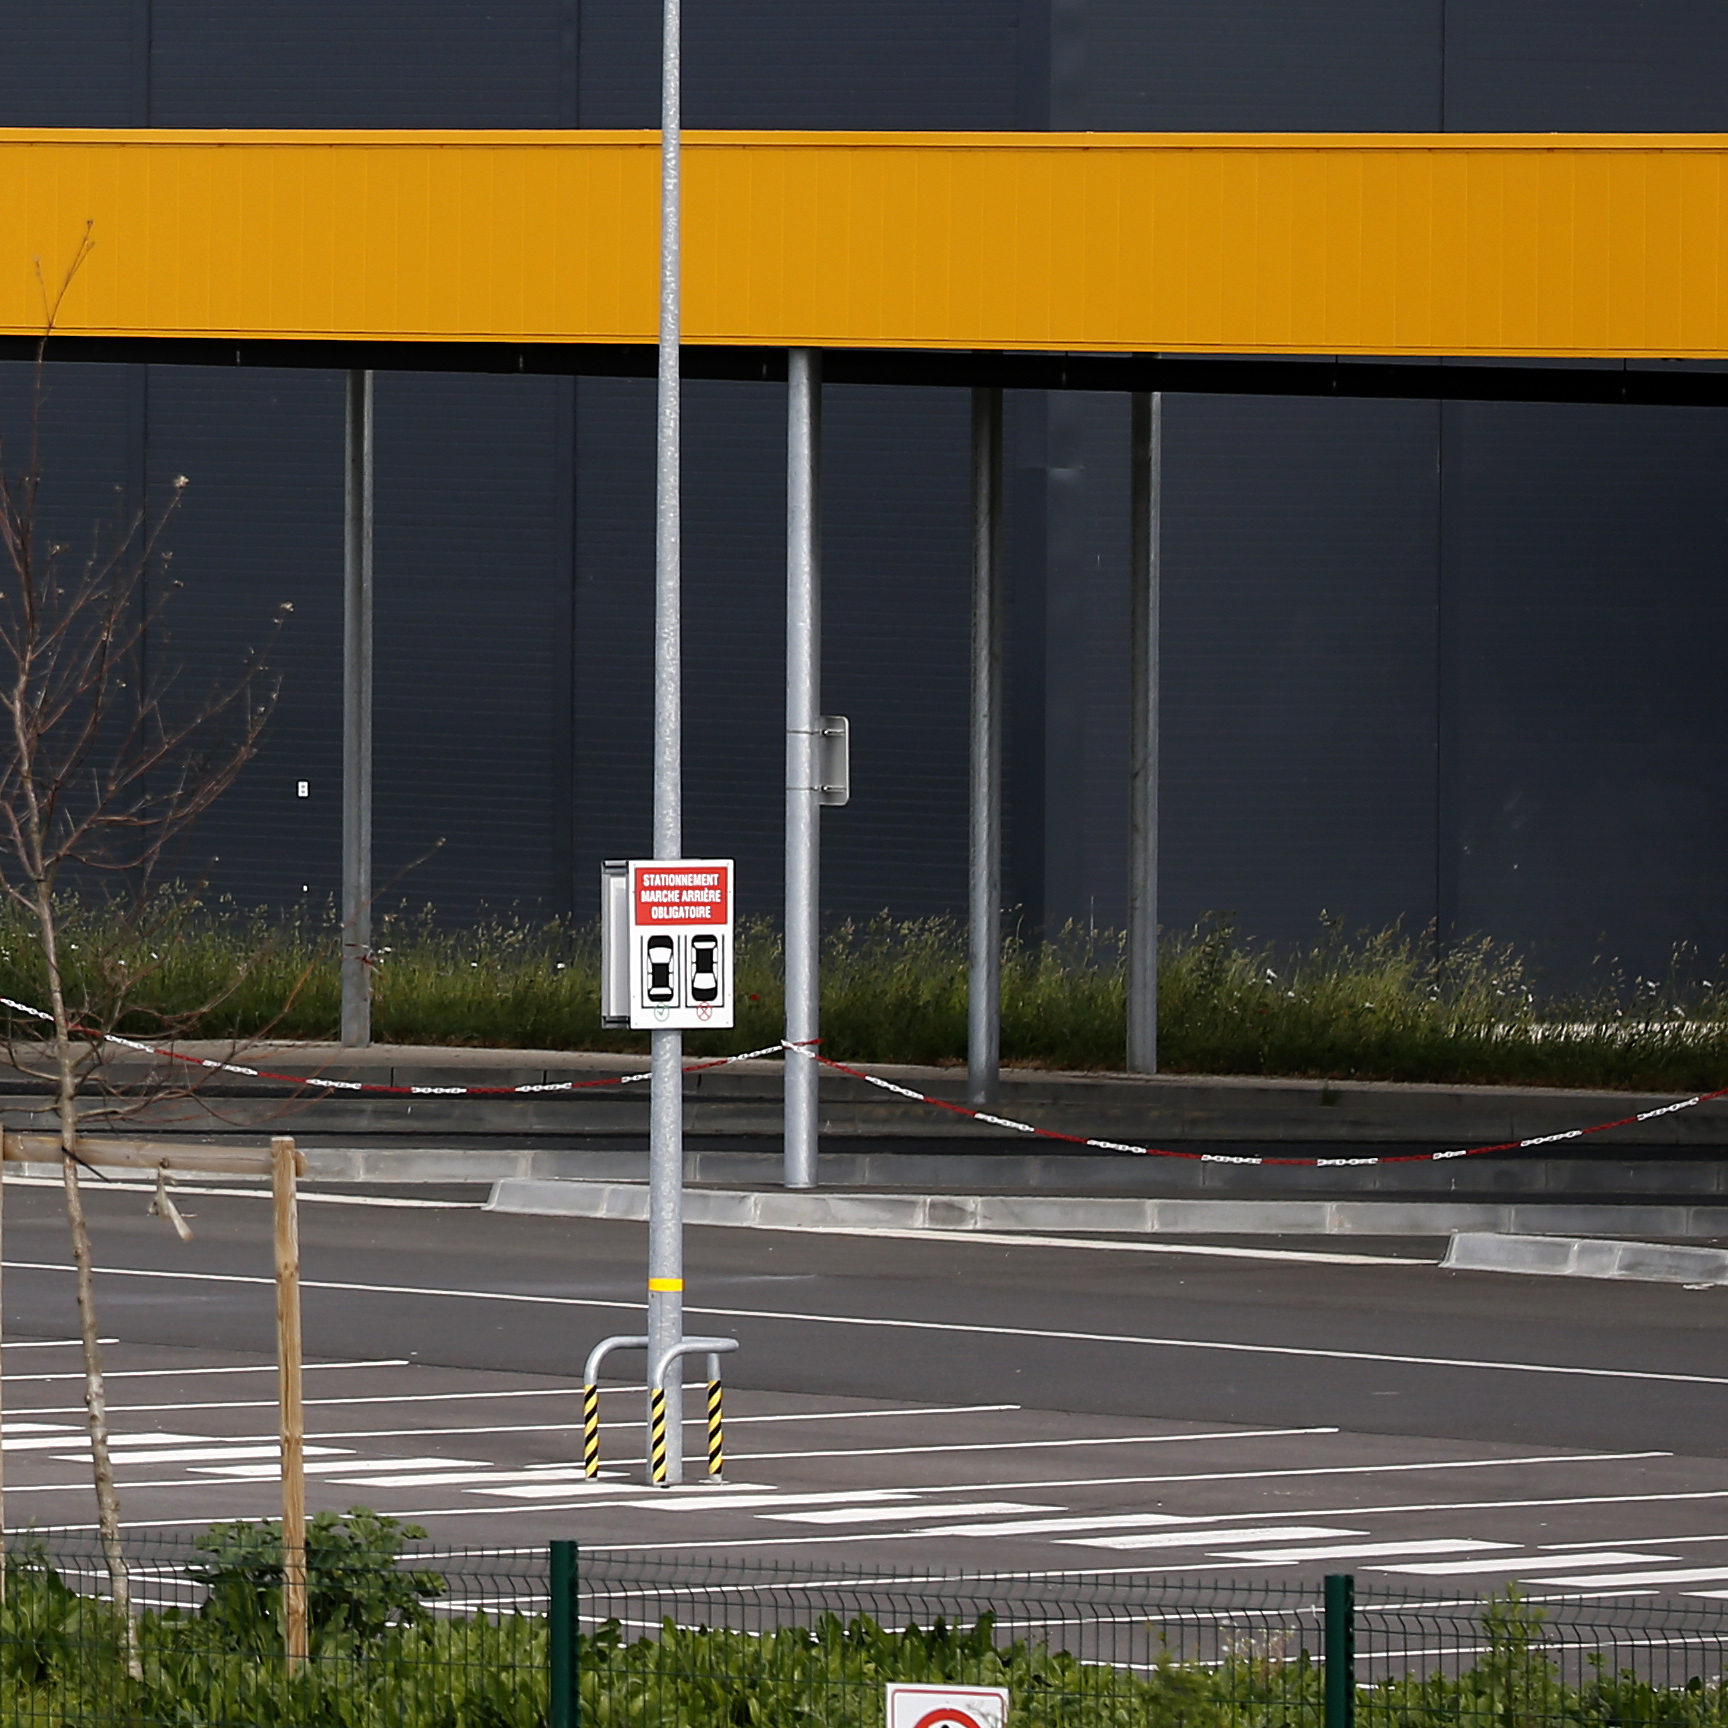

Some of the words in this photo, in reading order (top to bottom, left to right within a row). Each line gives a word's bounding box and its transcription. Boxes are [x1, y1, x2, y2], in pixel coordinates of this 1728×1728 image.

[642, 873, 719, 887] STATIONNEMENT
[640, 889, 680, 903] MARCHE
[681, 887, 722, 903] ARRIÈRE
[651, 905, 711, 919] OBLIGATOIRE
